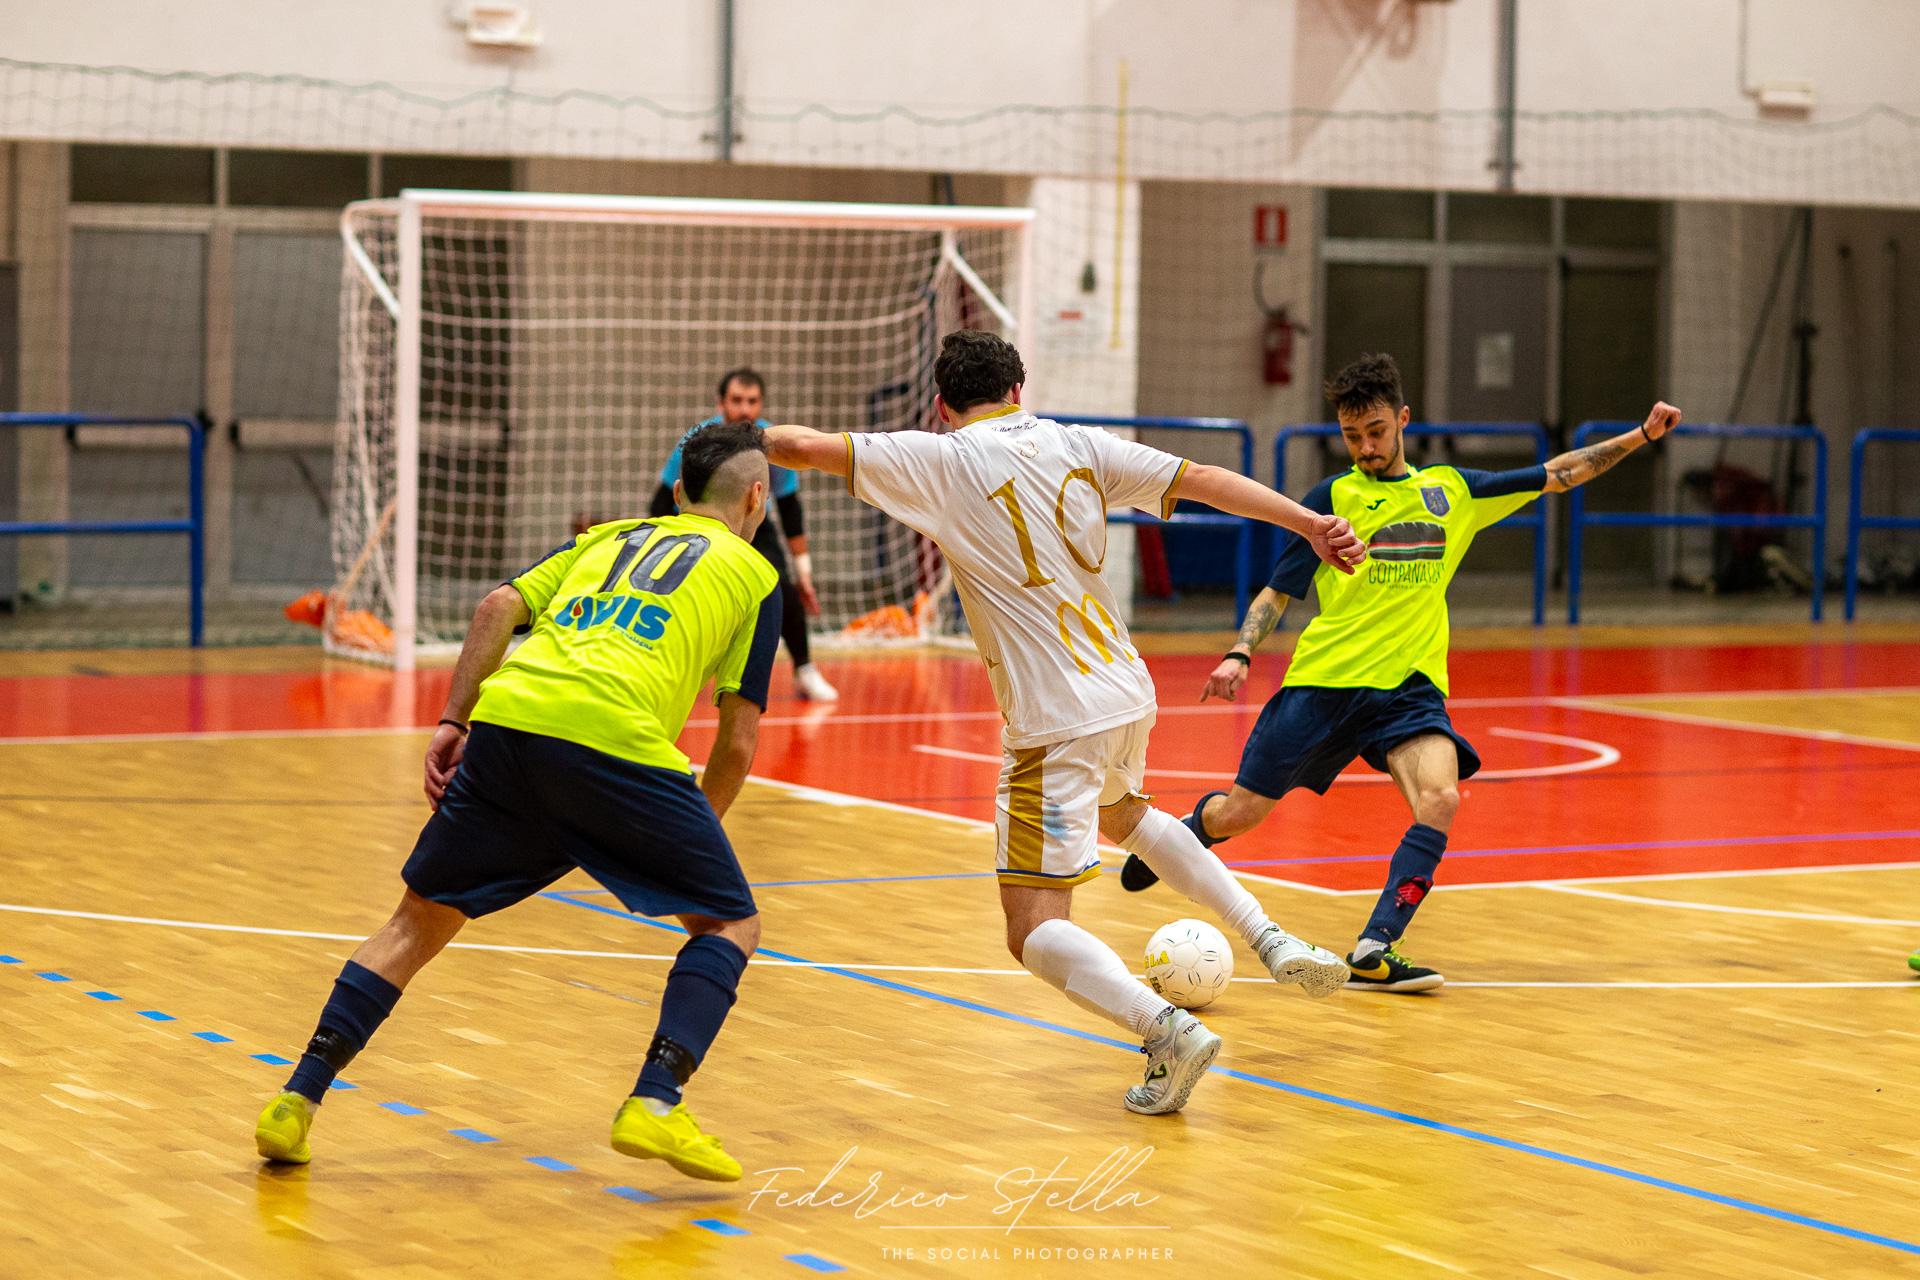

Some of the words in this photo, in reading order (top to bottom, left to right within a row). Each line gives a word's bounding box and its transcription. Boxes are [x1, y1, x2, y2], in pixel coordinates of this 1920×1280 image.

[597, 521, 711, 596] 10
[987, 467, 1107, 589] 10
[554, 595, 673, 642] AVIS
